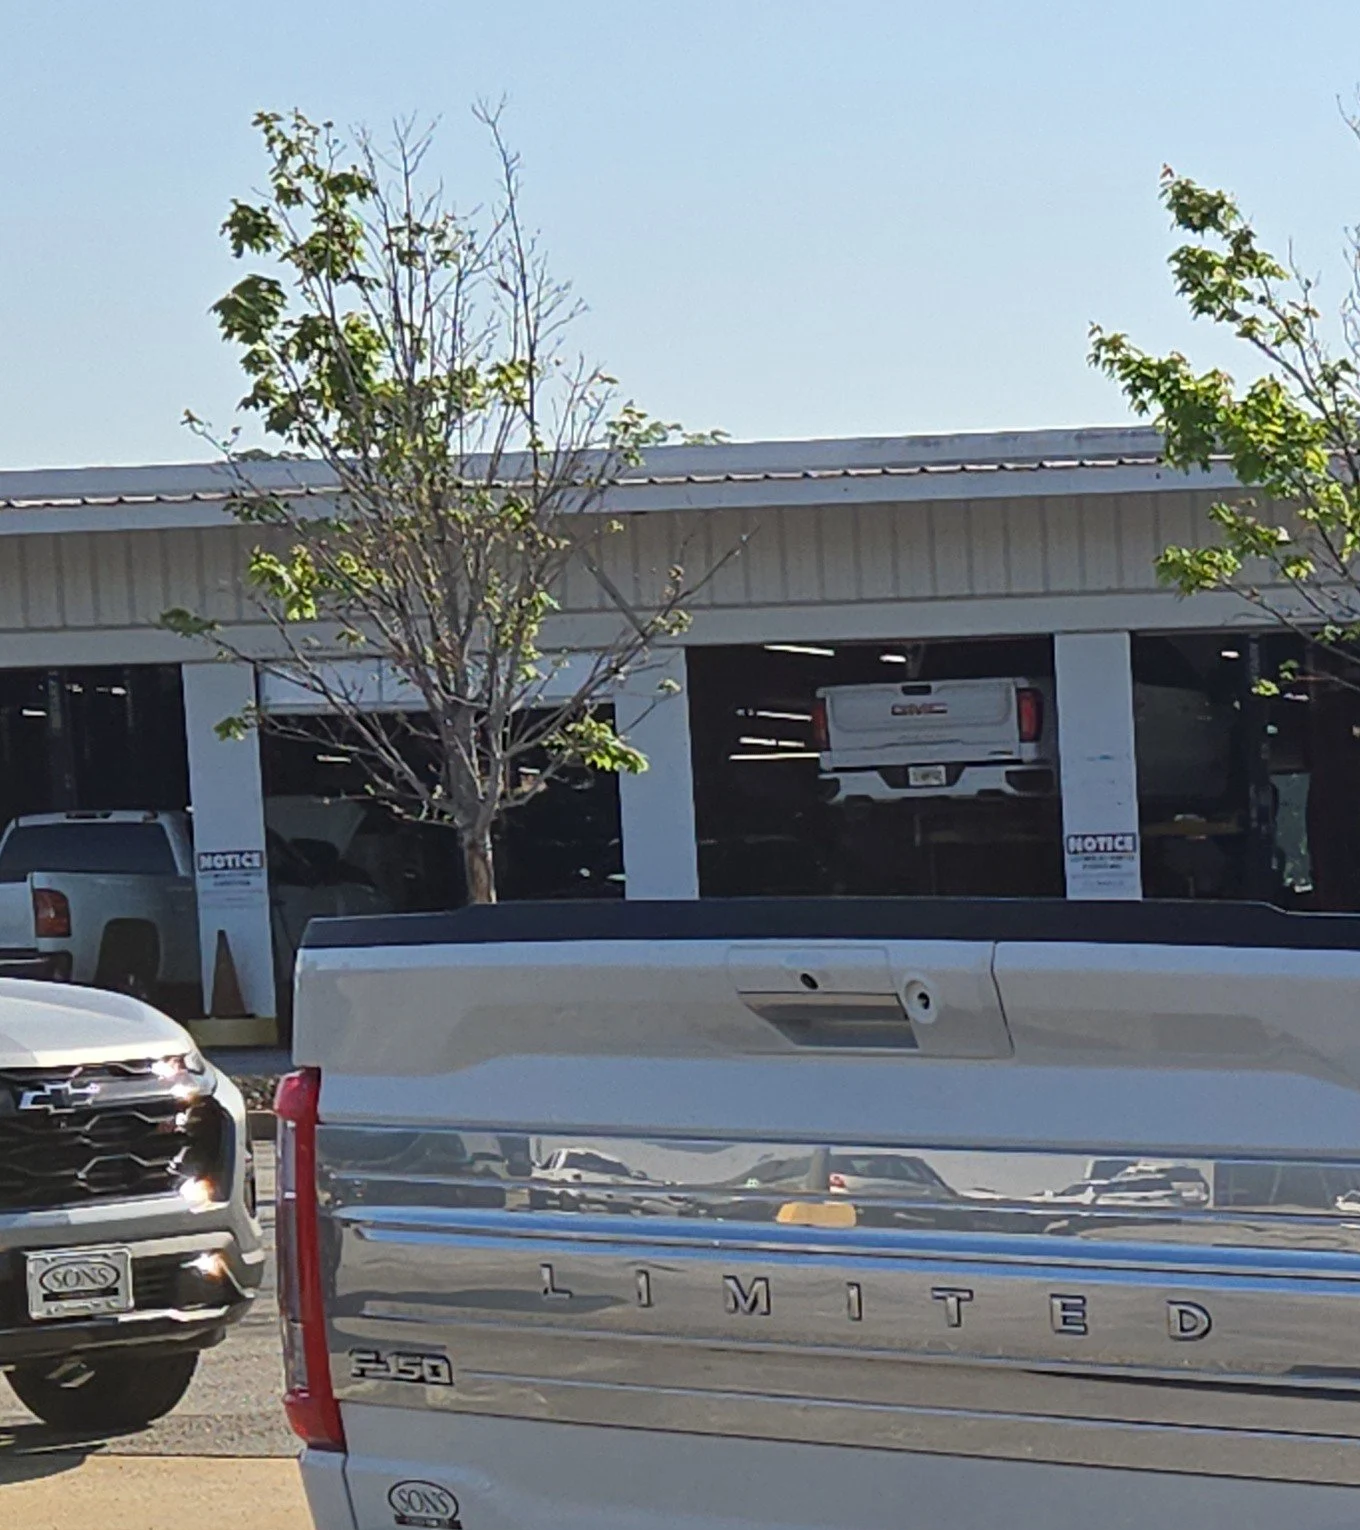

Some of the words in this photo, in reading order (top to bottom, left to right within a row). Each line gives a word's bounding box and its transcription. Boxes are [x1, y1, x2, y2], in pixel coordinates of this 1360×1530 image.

[891, 703, 948, 717] GMC
[1068, 835, 1134, 851] NOTICE
[200, 853, 261, 869] NOTICE
[51, 1267, 109, 1288] SONS
[540, 1263, 1212, 1341] LIMITED
[349, 1348, 454, 1385] F-150
[398, 1488, 450, 1516] SONS
